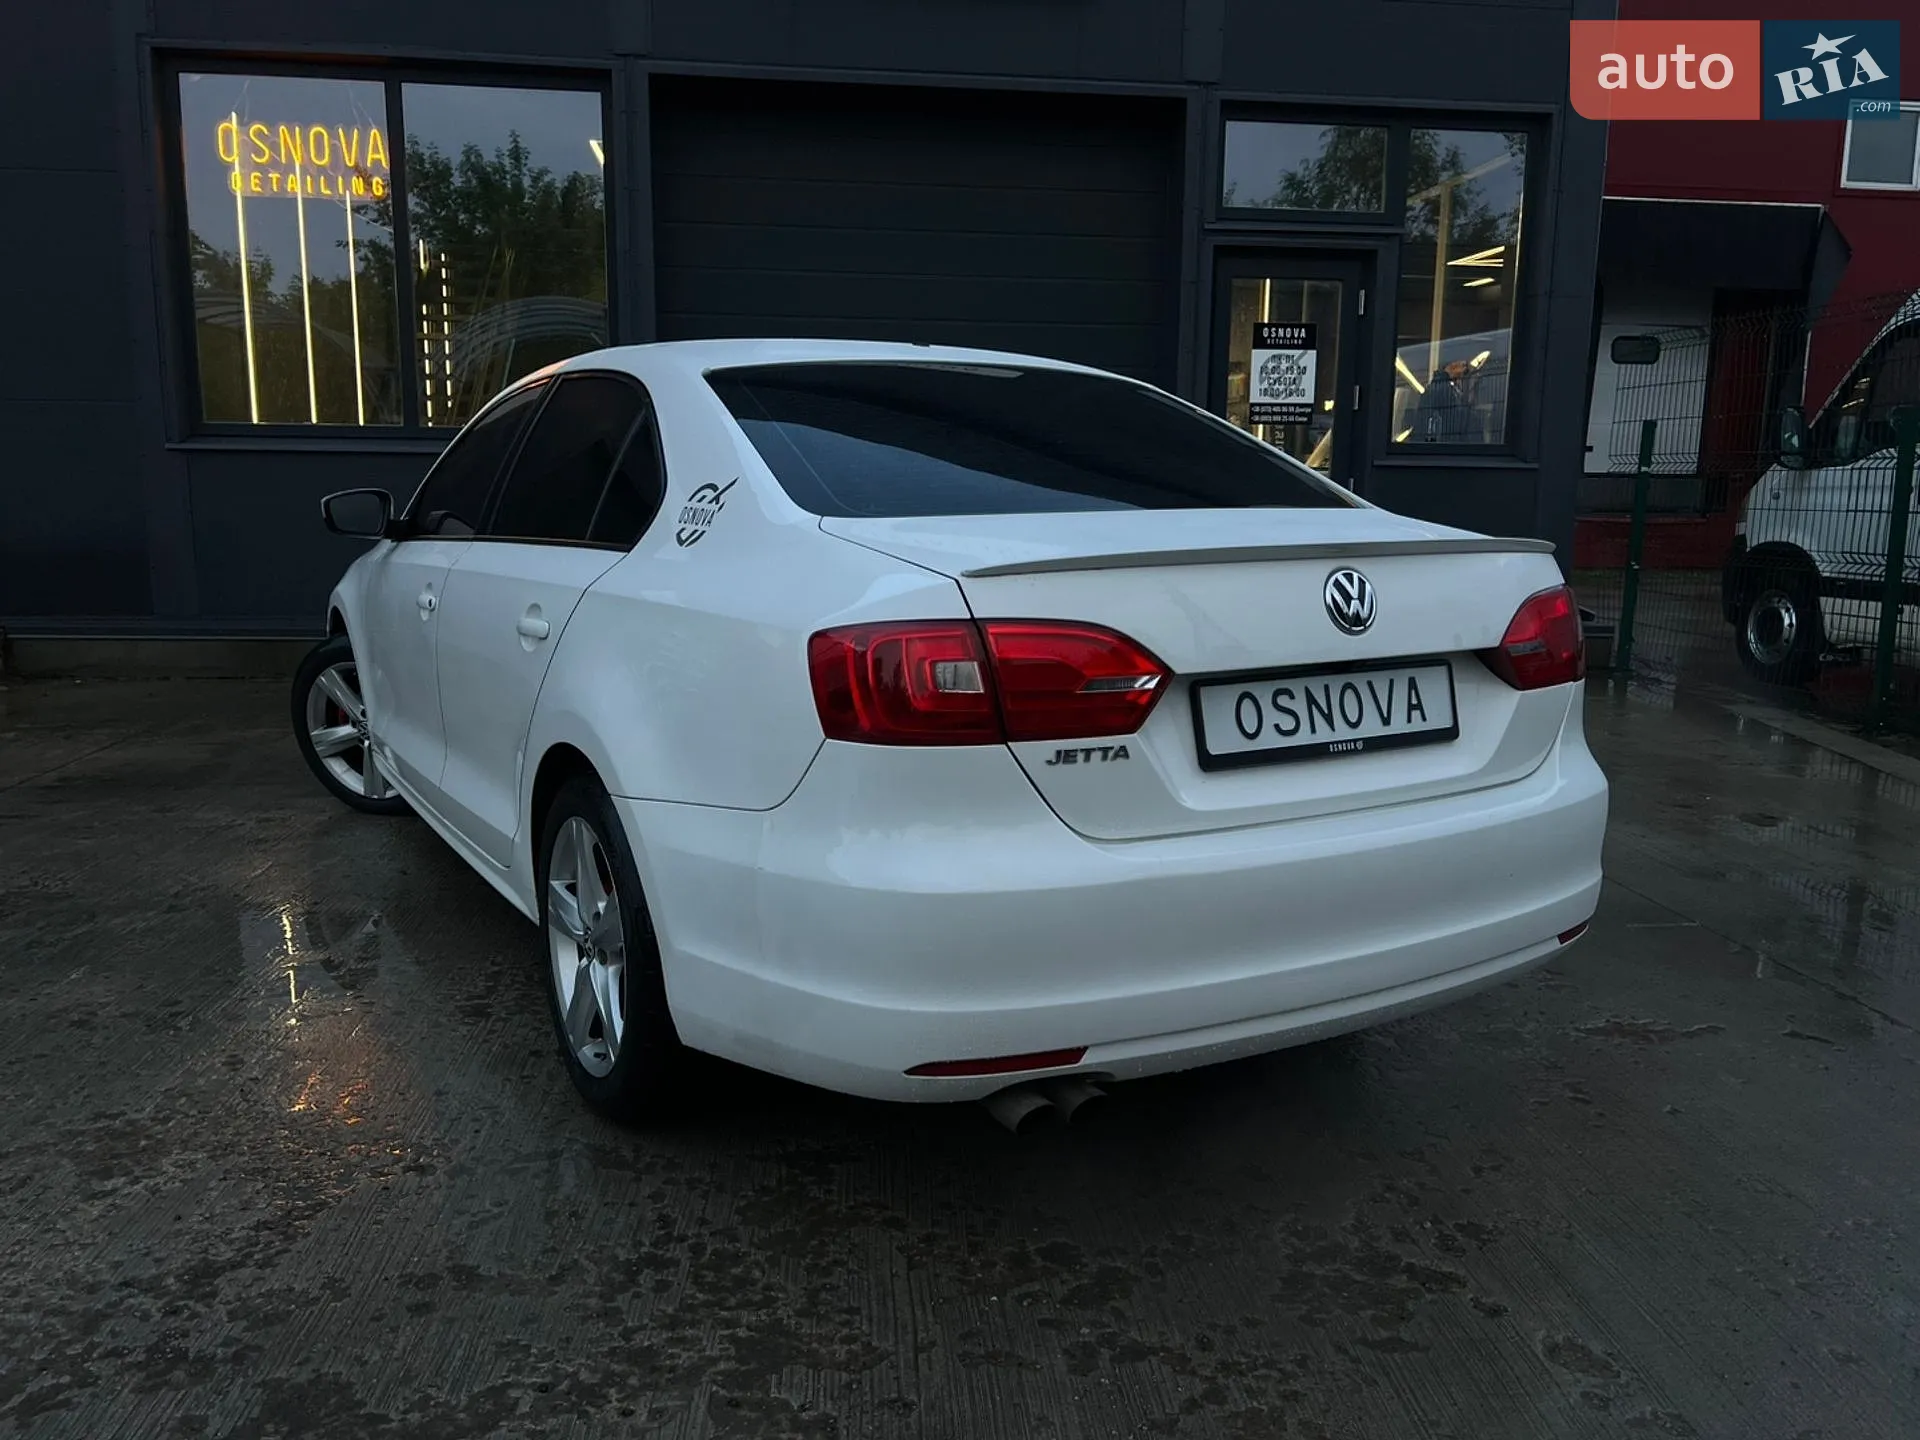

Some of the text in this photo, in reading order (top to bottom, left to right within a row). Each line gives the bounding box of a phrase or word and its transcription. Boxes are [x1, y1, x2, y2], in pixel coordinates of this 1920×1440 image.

[217, 121, 390, 169] OSNOVA
[230, 171, 386, 197] DETAILING
[1262, 327, 1306, 338] OSNOVA
[678, 505, 716, 528] OSNOVA
[1234, 676, 1428, 740] OSNOVA
[1045, 745, 1130, 766] JETTA
